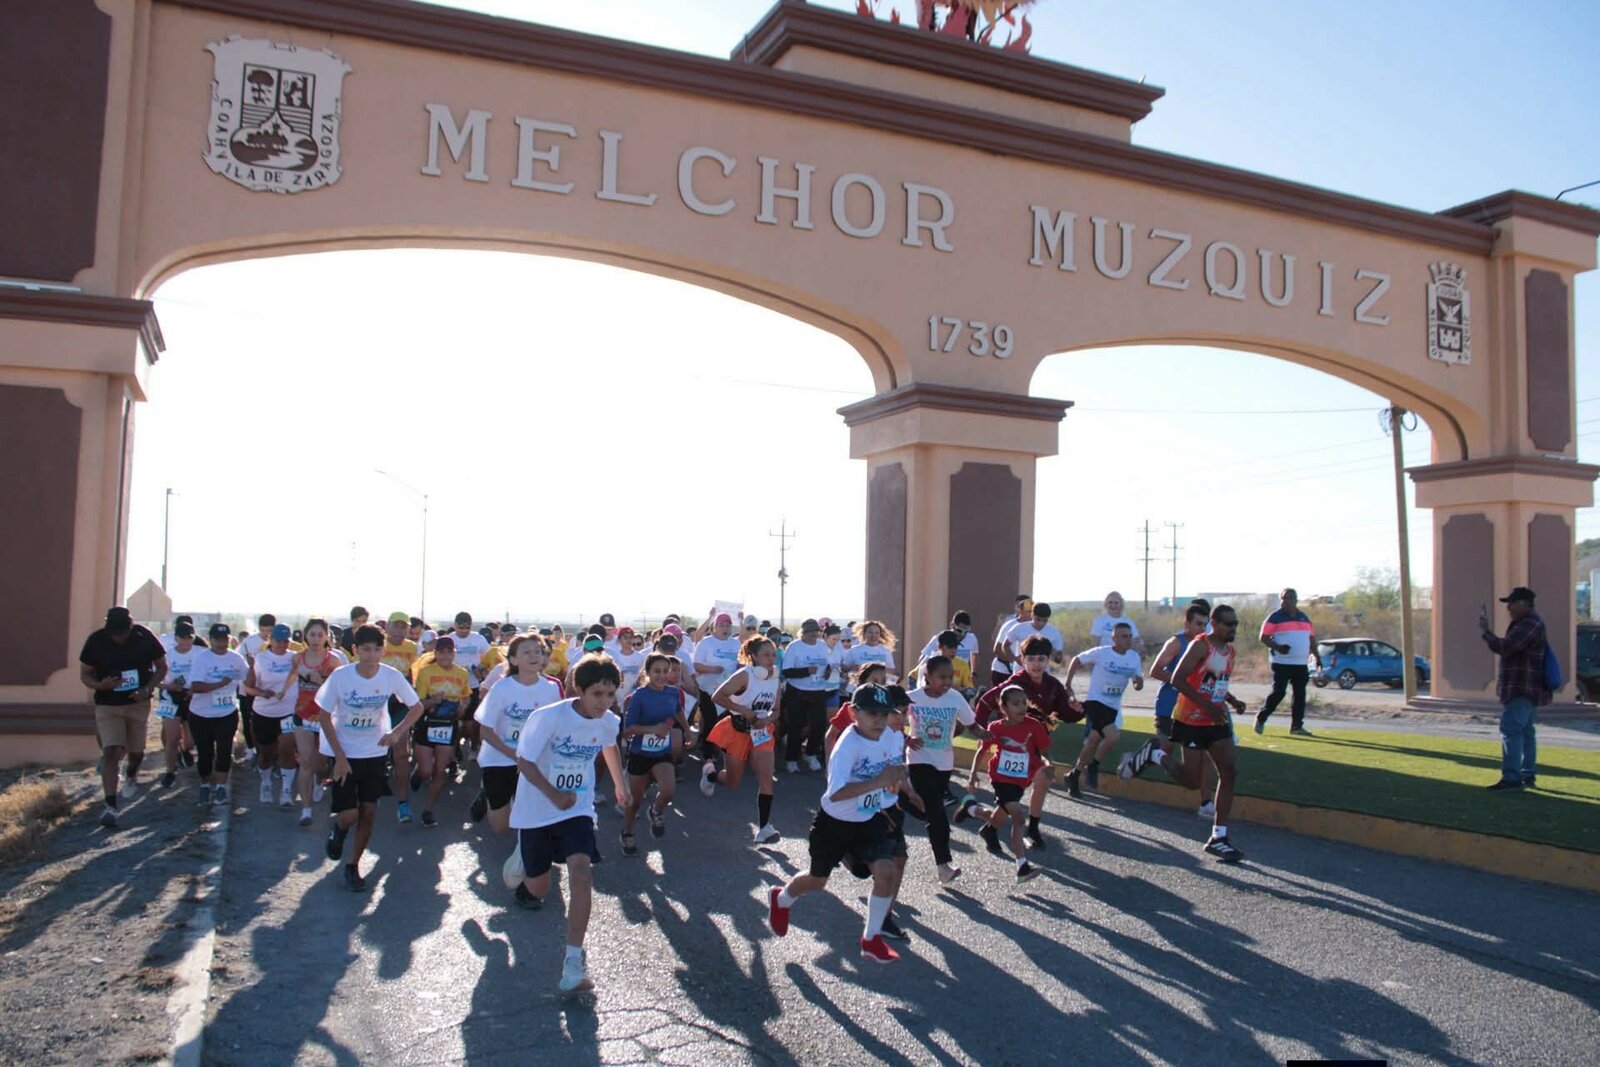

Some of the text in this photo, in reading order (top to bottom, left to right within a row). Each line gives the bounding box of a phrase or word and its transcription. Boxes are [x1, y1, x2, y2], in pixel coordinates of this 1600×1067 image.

[264, 171, 284, 183] DE
[292, 112, 335, 187] ZARAGOZA
[420, 102, 1392, 326] MELCHOR MUZQUIZ
[928, 313, 1014, 359] 1739
[352, 717, 373, 727] 011
[556, 773, 584, 789] 009
[1004, 759, 1026, 773] 023
